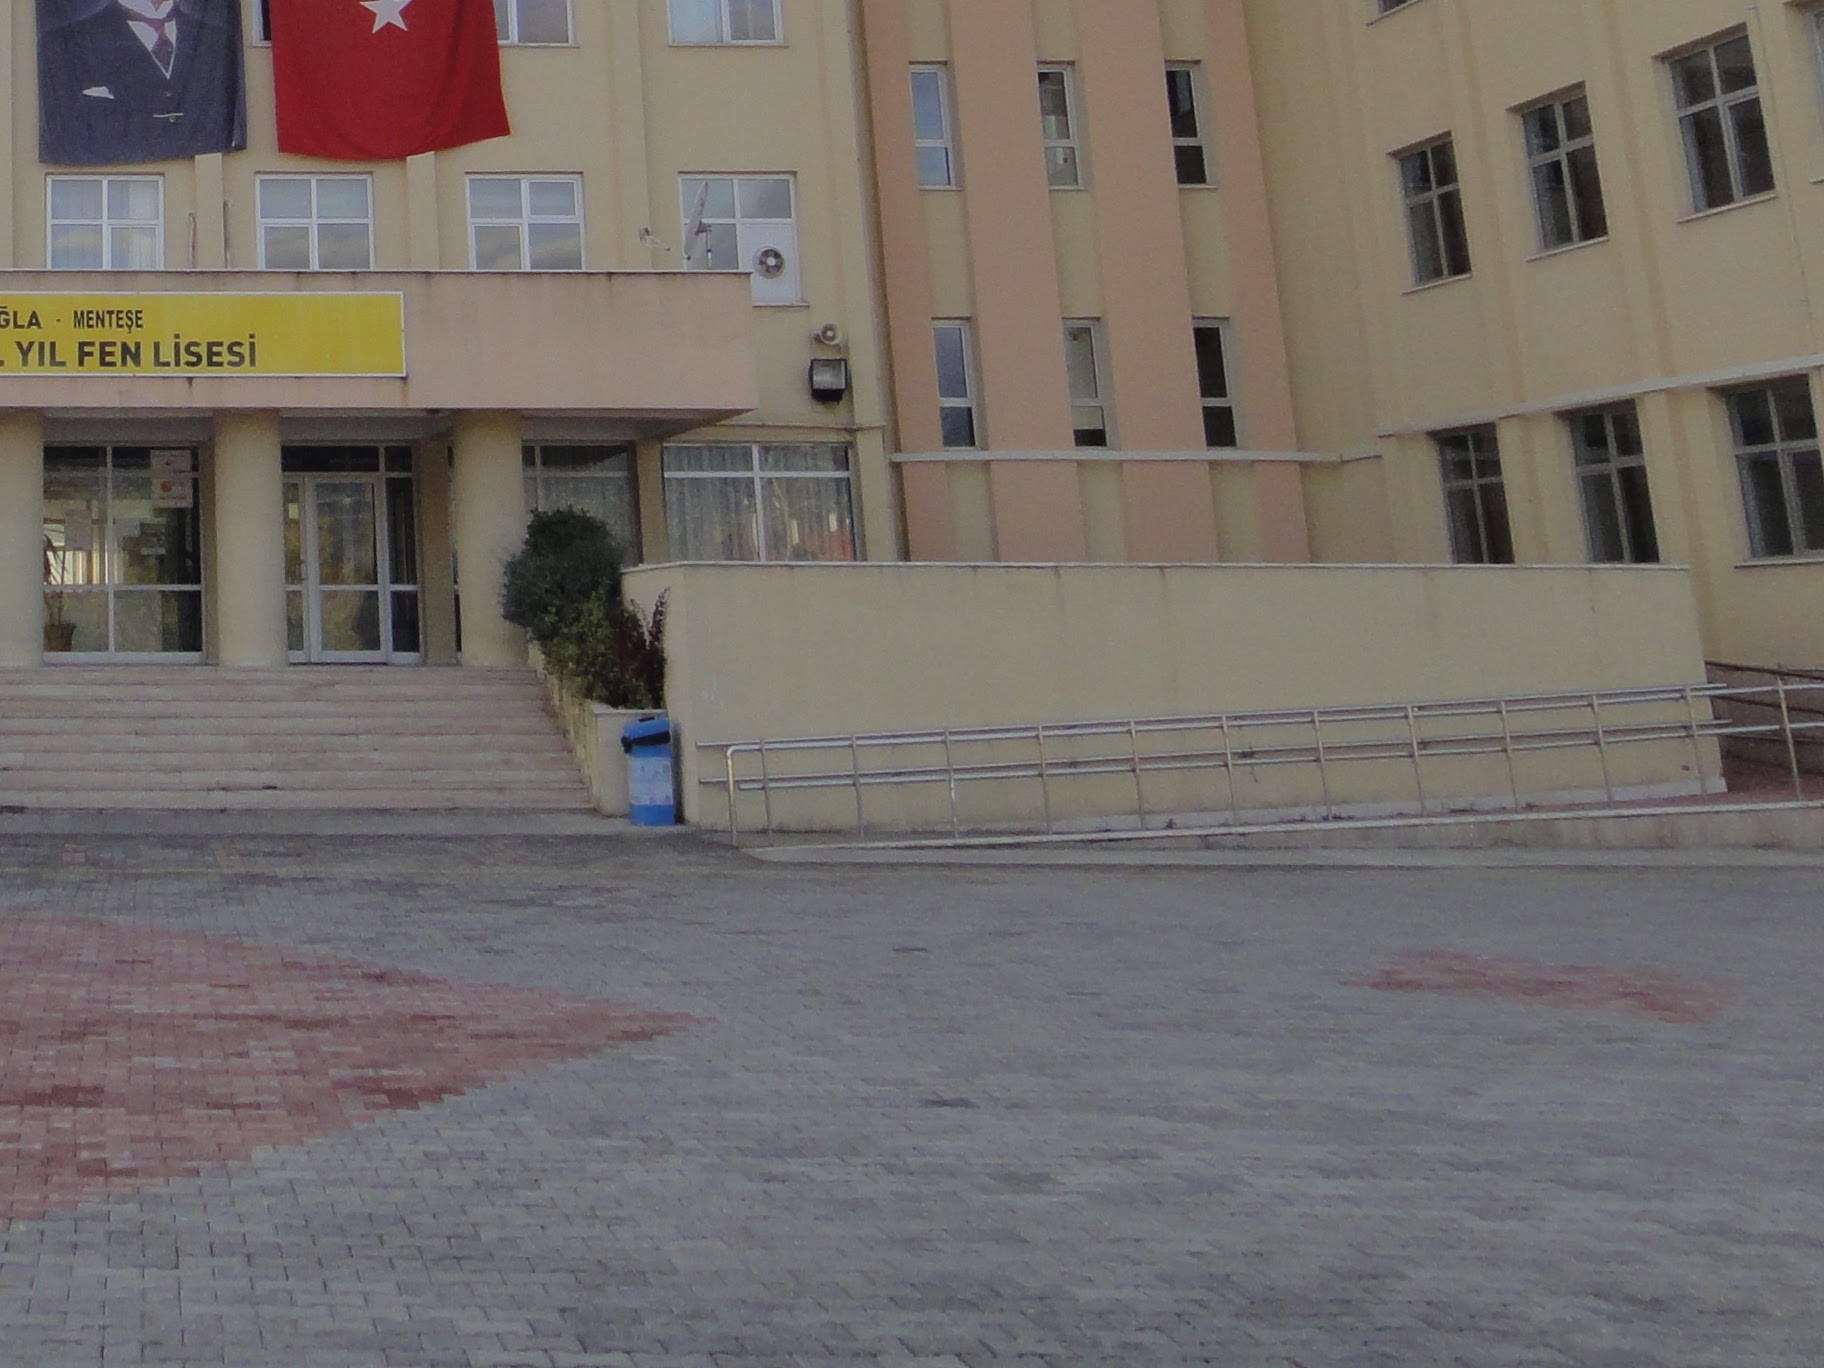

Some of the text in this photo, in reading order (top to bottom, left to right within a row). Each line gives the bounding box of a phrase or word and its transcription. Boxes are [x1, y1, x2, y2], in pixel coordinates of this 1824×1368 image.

[72, 309, 143, 333] MENTEŞE
[15, 340, 67, 367] YIL
[77, 340, 141, 367] FEN
[153, 333, 256, 367] LİSESİ
